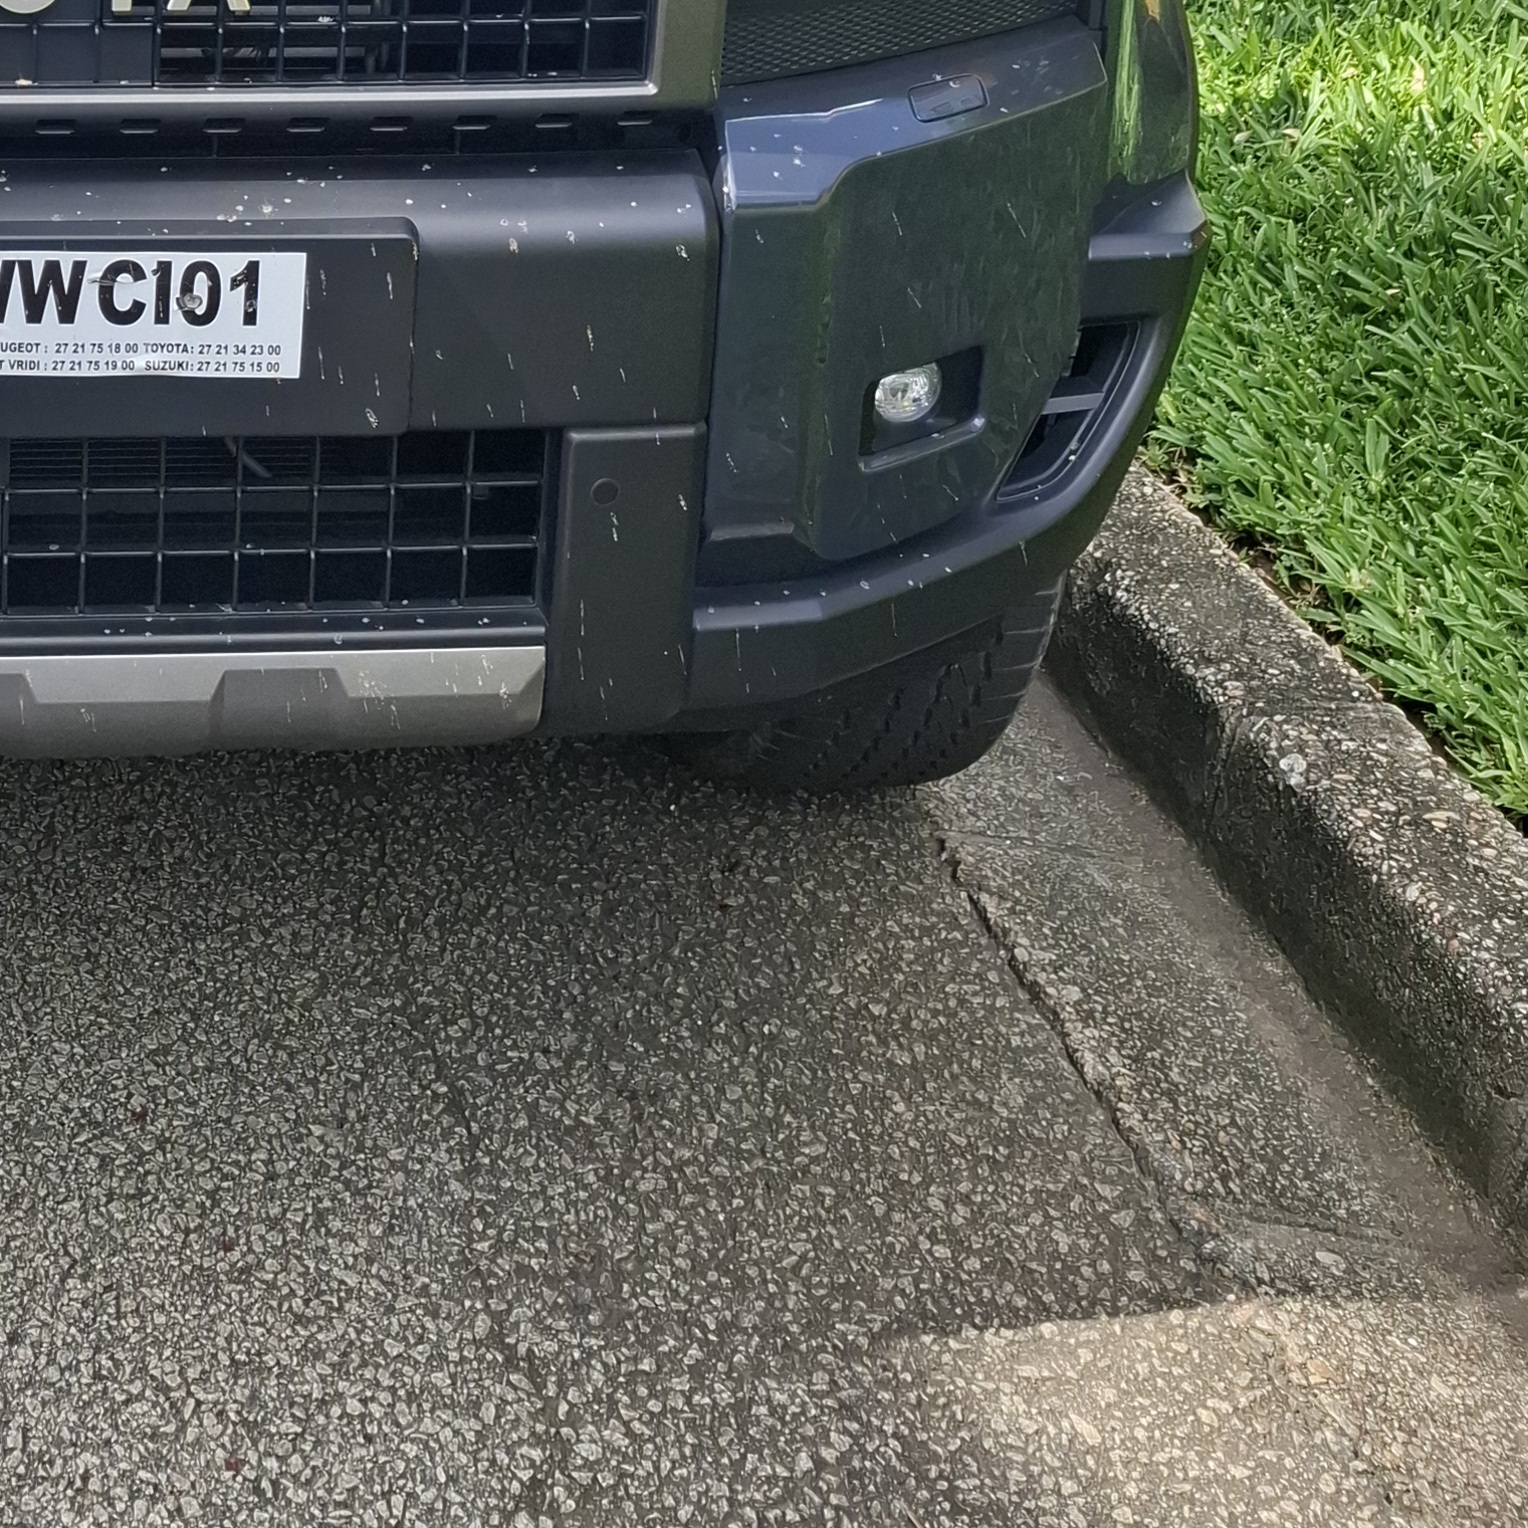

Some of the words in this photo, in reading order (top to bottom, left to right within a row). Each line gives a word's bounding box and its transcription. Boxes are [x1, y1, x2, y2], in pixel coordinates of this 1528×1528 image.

[54, 343, 69, 354] 27
[72, 343, 85, 354] 21
[89, 343, 104, 354] 75
[107, 343, 121, 354] 18
[124, 343, 139, 354] 00
[198, 344, 212, 355] 27
[215, 344, 229, 355] 21
[232, 344, 247, 356] 34
[250, 344, 264, 356] 23
[267, 345, 282, 356] 00
[51, 360, 66, 372] 27
[69, 360, 82, 372] 21
[86, 360, 100, 372] 75
[103, 360, 118, 372] 19
[121, 360, 136, 372] 00
[196, 361, 211, 372] 27
[214, 361, 227, 372] 21
[231, 361, 246, 373] 75
[249, 361, 263, 373] 15
[266, 361, 281, 373] 00
